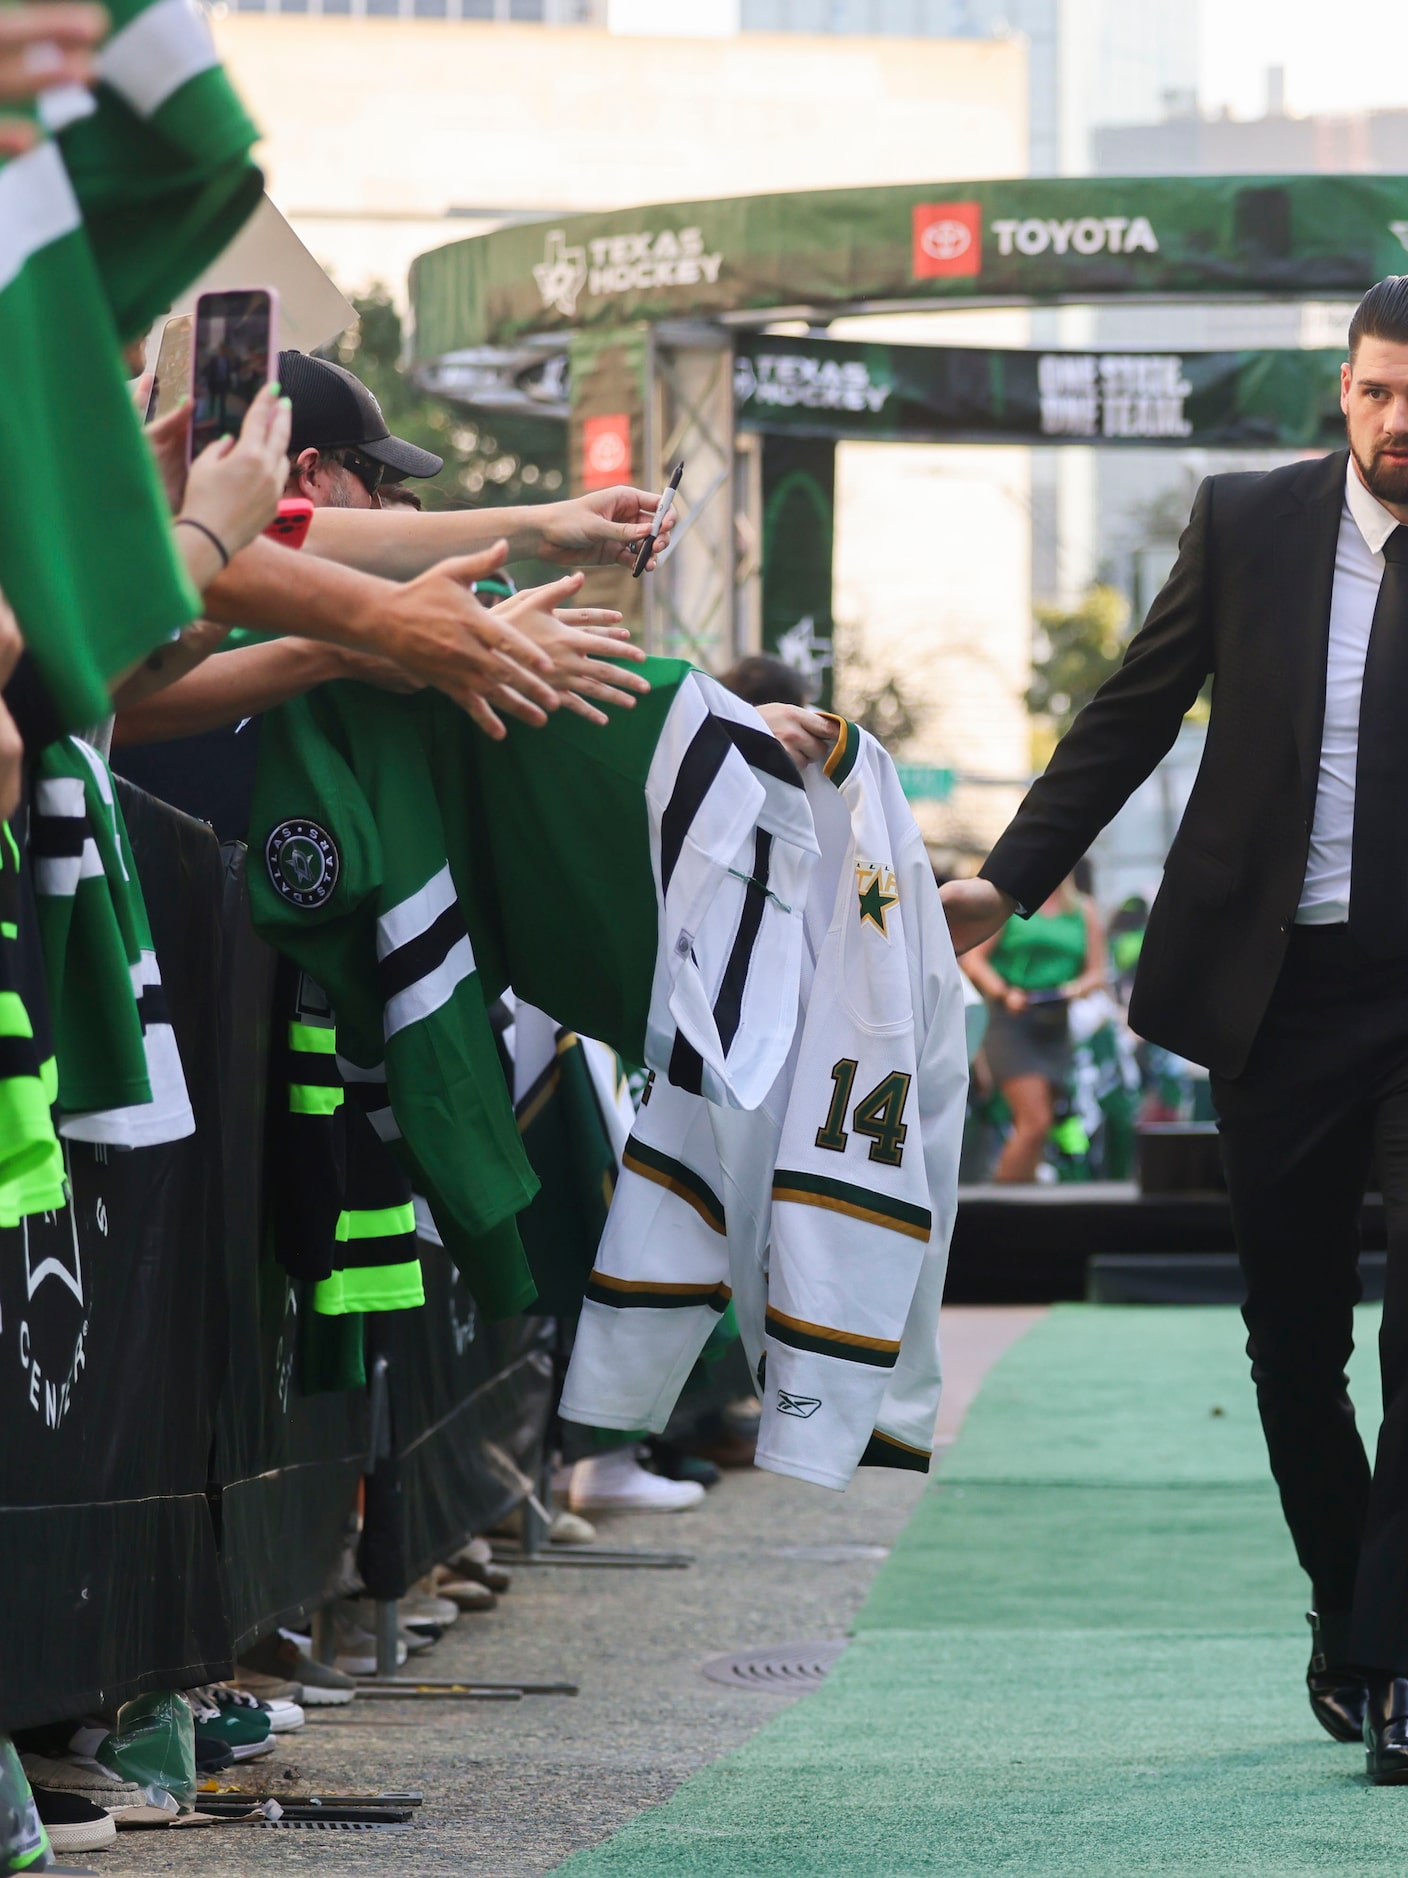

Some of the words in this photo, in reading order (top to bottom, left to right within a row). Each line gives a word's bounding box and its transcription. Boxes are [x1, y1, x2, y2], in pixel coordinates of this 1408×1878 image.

[589, 227, 704, 263] TEXAS
[991, 216, 1159, 255] TOYOTA
[589, 252, 723, 295] HOCKEY
[756, 355, 870, 389] TEXAS
[755, 382, 891, 412] HOCKEY
[271, 828, 302, 902] DALLAS
[309, 828, 334, 896] STARS
[814, 1057, 912, 1168] 14
